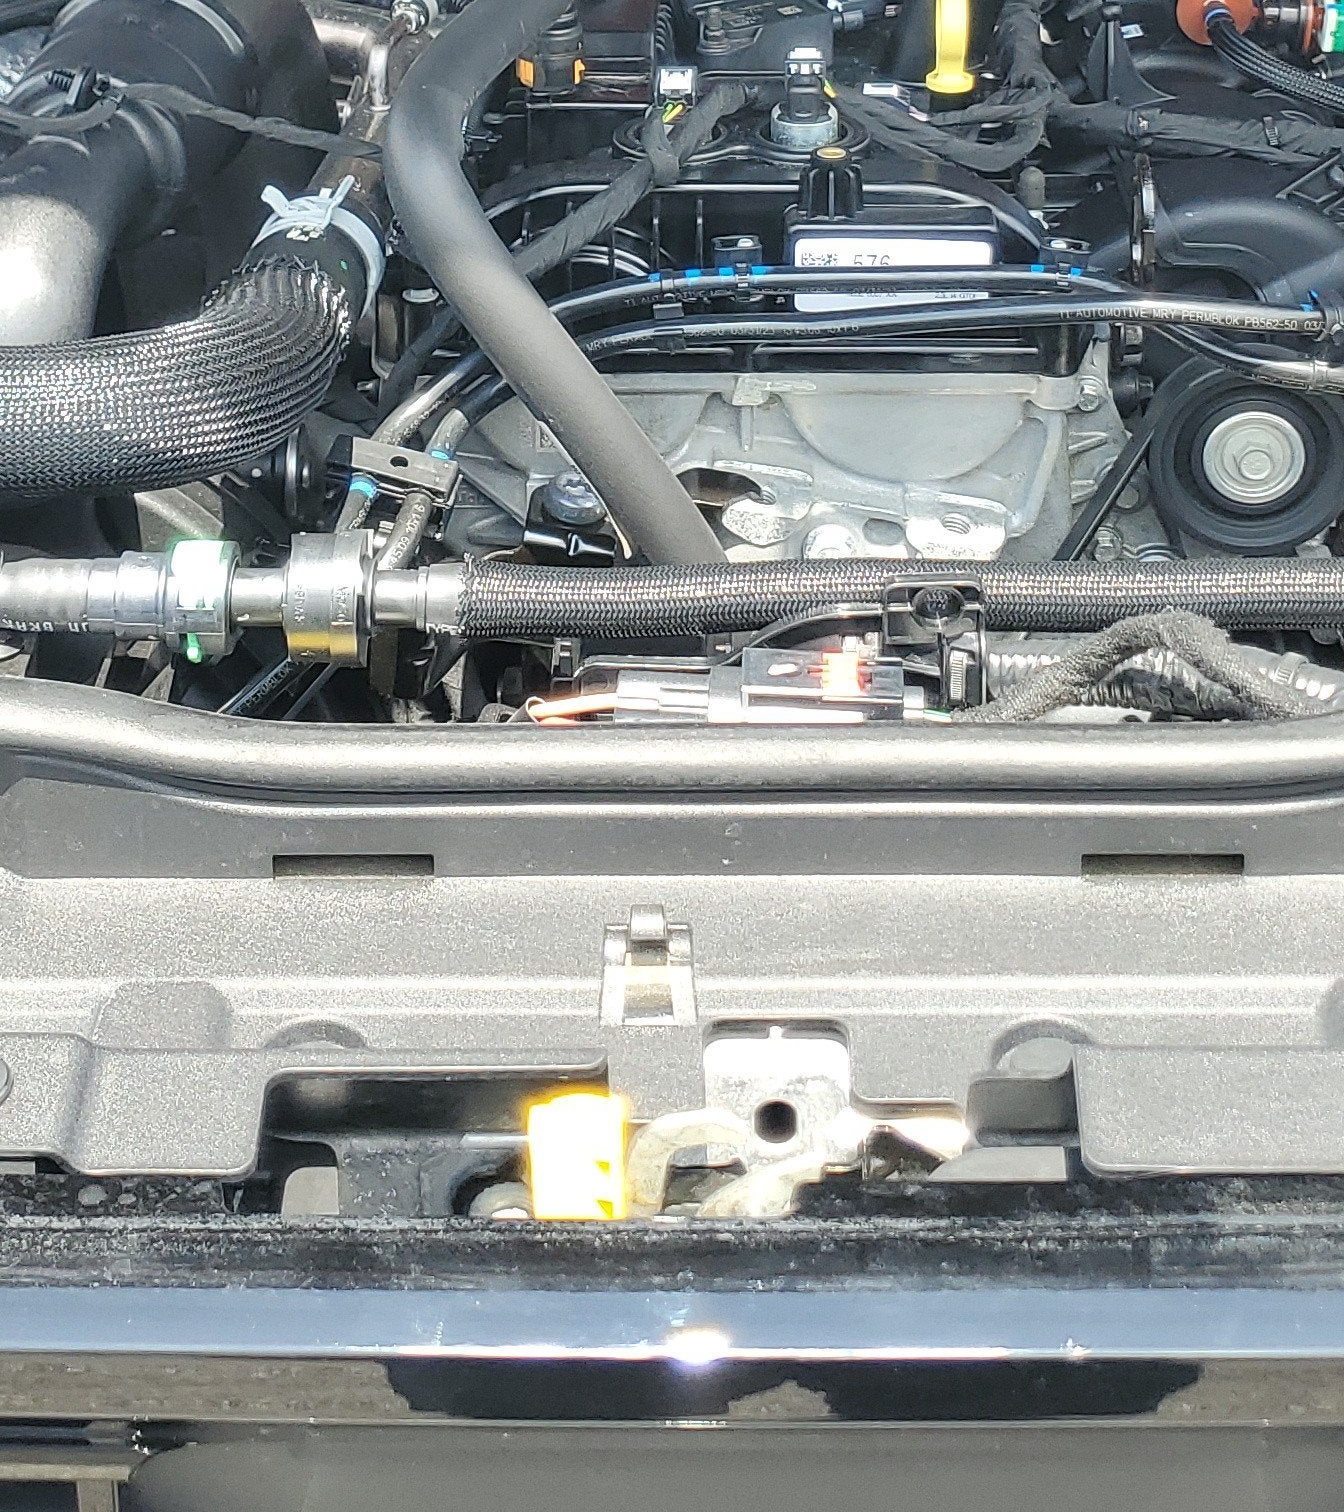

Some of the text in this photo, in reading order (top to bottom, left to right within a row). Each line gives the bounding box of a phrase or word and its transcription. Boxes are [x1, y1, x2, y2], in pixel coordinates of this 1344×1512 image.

[1075, 306, 1148, 320] AUTOMOTIVE
[1153, 308, 1176, 320] MRY
[1182, 310, 1240, 326] PERMBLOK
[1244, 316, 1298, 331] PB562-50
